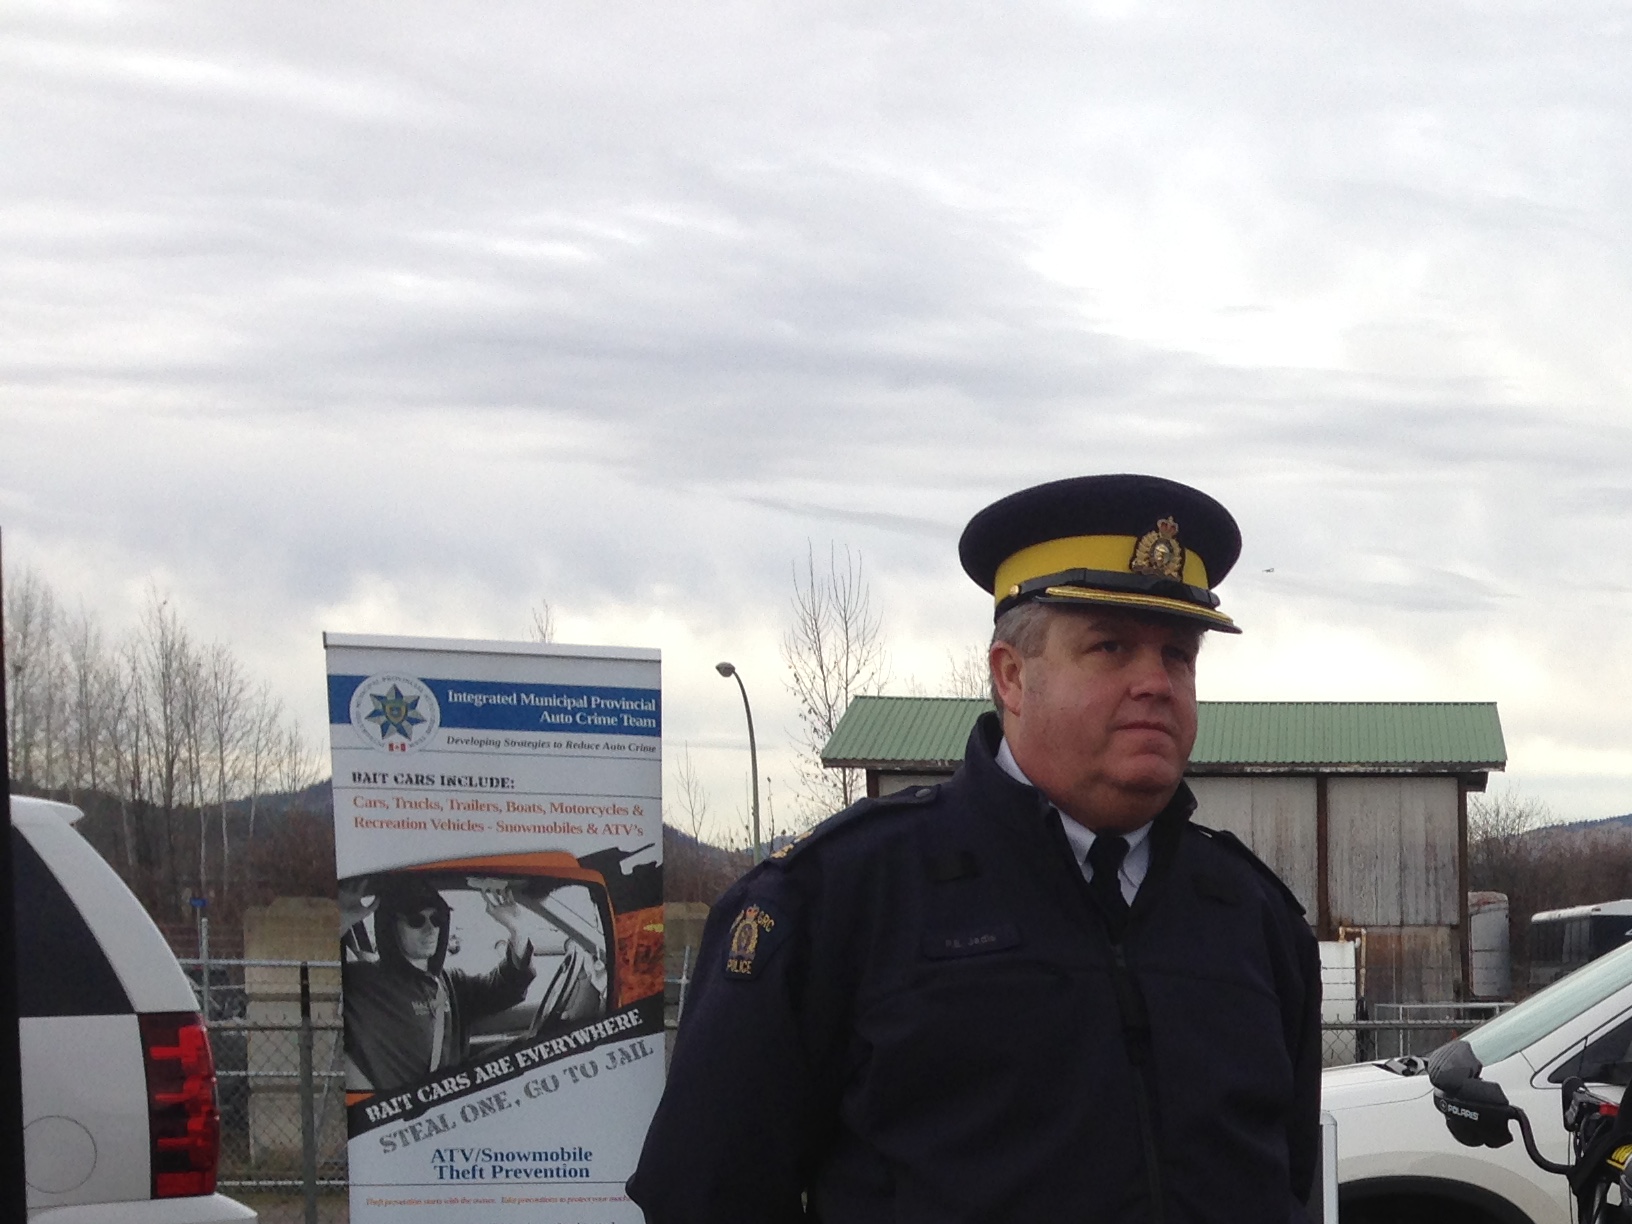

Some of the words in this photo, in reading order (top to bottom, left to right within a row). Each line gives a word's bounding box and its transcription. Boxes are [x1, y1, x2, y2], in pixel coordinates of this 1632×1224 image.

[447, 690, 517, 706] Integrated
[520, 693, 587, 711] Municipal
[591, 696, 656, 711] Provincial
[539, 711, 572, 724] Auto
[576, 712, 617, 726] Crime
[621, 714, 656, 728] Team
[447, 736, 500, 748] Developing
[504, 738, 549, 750] Strategies
[566, 740, 599, 750] Reduce
[602, 741, 625, 751] Auto
[629, 742, 656, 752] Crime
[352, 772, 388, 784] BAIT
[394, 773, 435, 786] CARS
[441, 775, 514, 789] INCLUDE:
[353, 796, 389, 810] Cars,
[392, 797, 444, 811] Trucks,
[447, 799, 501, 813] Trailers,
[506, 801, 546, 815] Boats,
[550, 803, 628, 817] Motorcycles
[633, 805, 643, 816] &
[354, 817, 426, 830] Recreation
[429, 818, 484, 831] Vehicles
[496, 820, 582, 834] Snowmobiles
[586, 823, 598, 834] &
[602, 824, 643, 836] ATV's
[365, 1092, 412, 1122] BAIT
[416, 1073, 470, 1103] CARS
[475, 1056, 513, 1083] ARE
[519, 1009, 643, 1068] EVERYWHERE
[380, 1112, 456, 1153] STEAL
[460, 1090, 521, 1123] ONE,
[524, 1074, 560, 1100] GO
[563, 1061, 599, 1084] TO
[605, 1039, 654, 1070] JAIL
[1447, 1104, 1479, 1121] POLARIS
[431, 1147, 593, 1163] ATV/Snowmobile
[434, 1164, 484, 1180] Theft
[492, 1163, 590, 1179] Prevention
